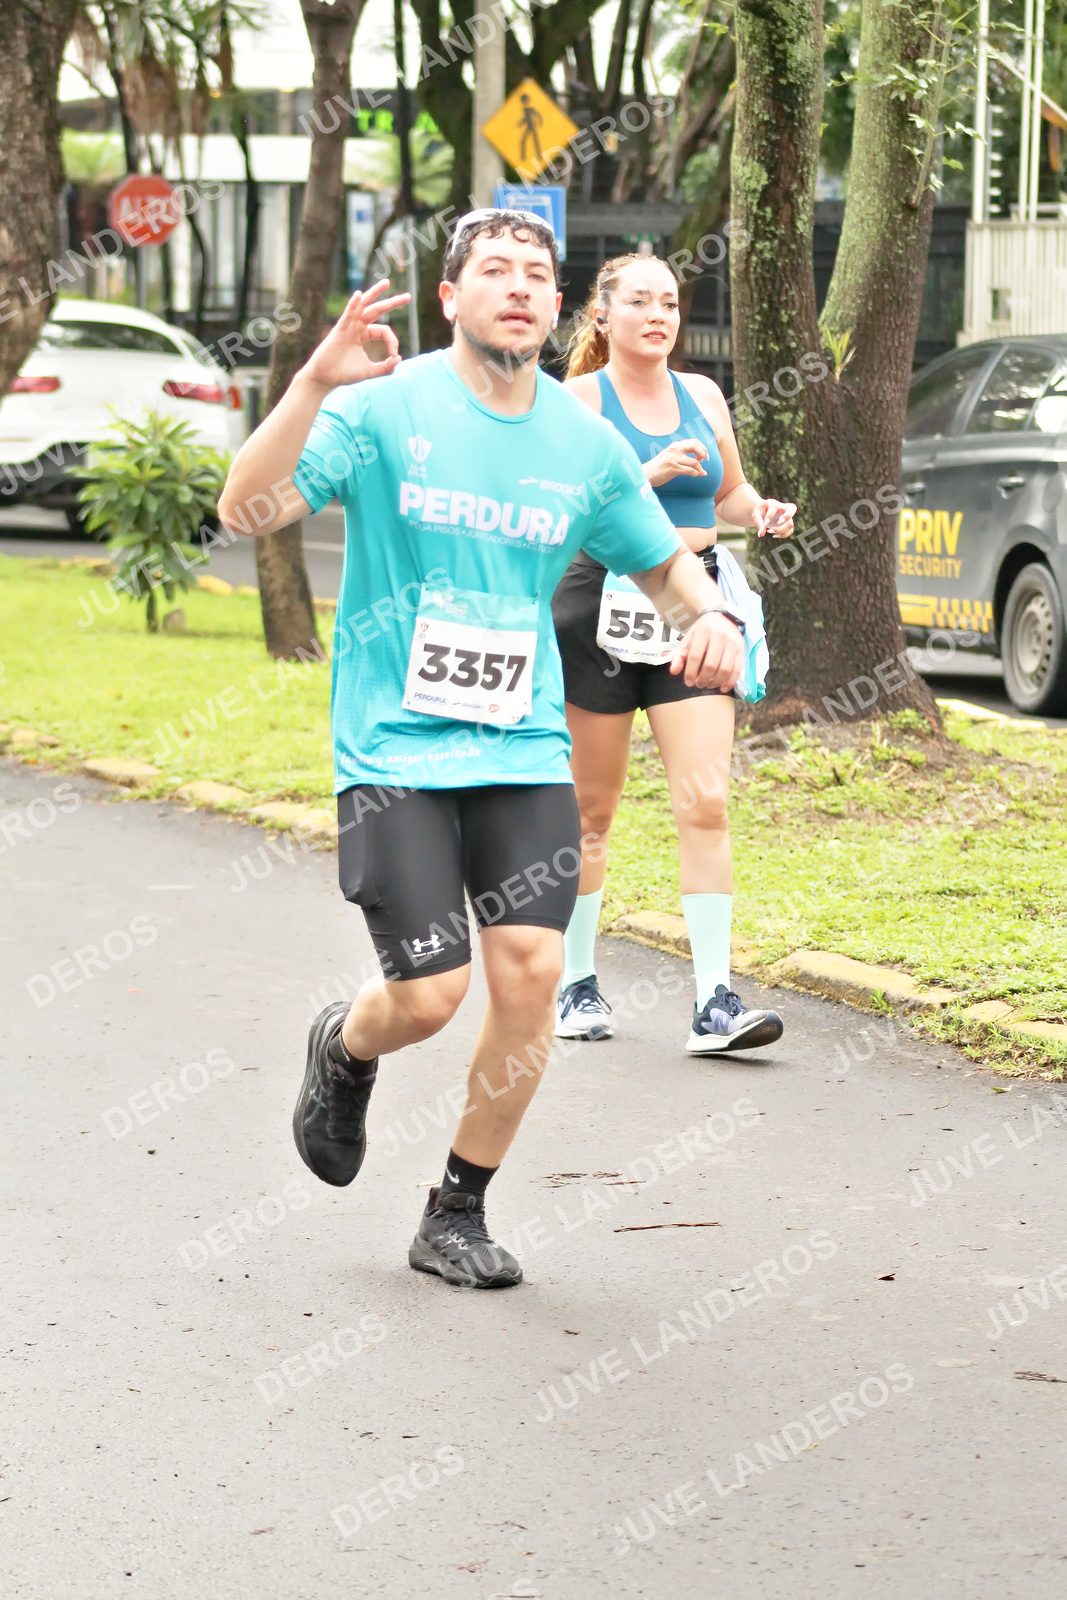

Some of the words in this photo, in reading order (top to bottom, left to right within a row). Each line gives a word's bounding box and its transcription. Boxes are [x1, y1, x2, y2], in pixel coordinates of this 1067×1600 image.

[540, 479, 585, 496] BROOKS
[399, 481, 570, 545] PERDURA
[409, 520, 432, 533] PEGA
[433, 525, 461, 536] PISOS
[899, 508, 963, 556] PRIV
[899, 554, 962, 578] SECURITY
[606, 609, 685, 642] 551
[418, 643, 528, 692] 3357
[414, 692, 447, 704] PERDURA
